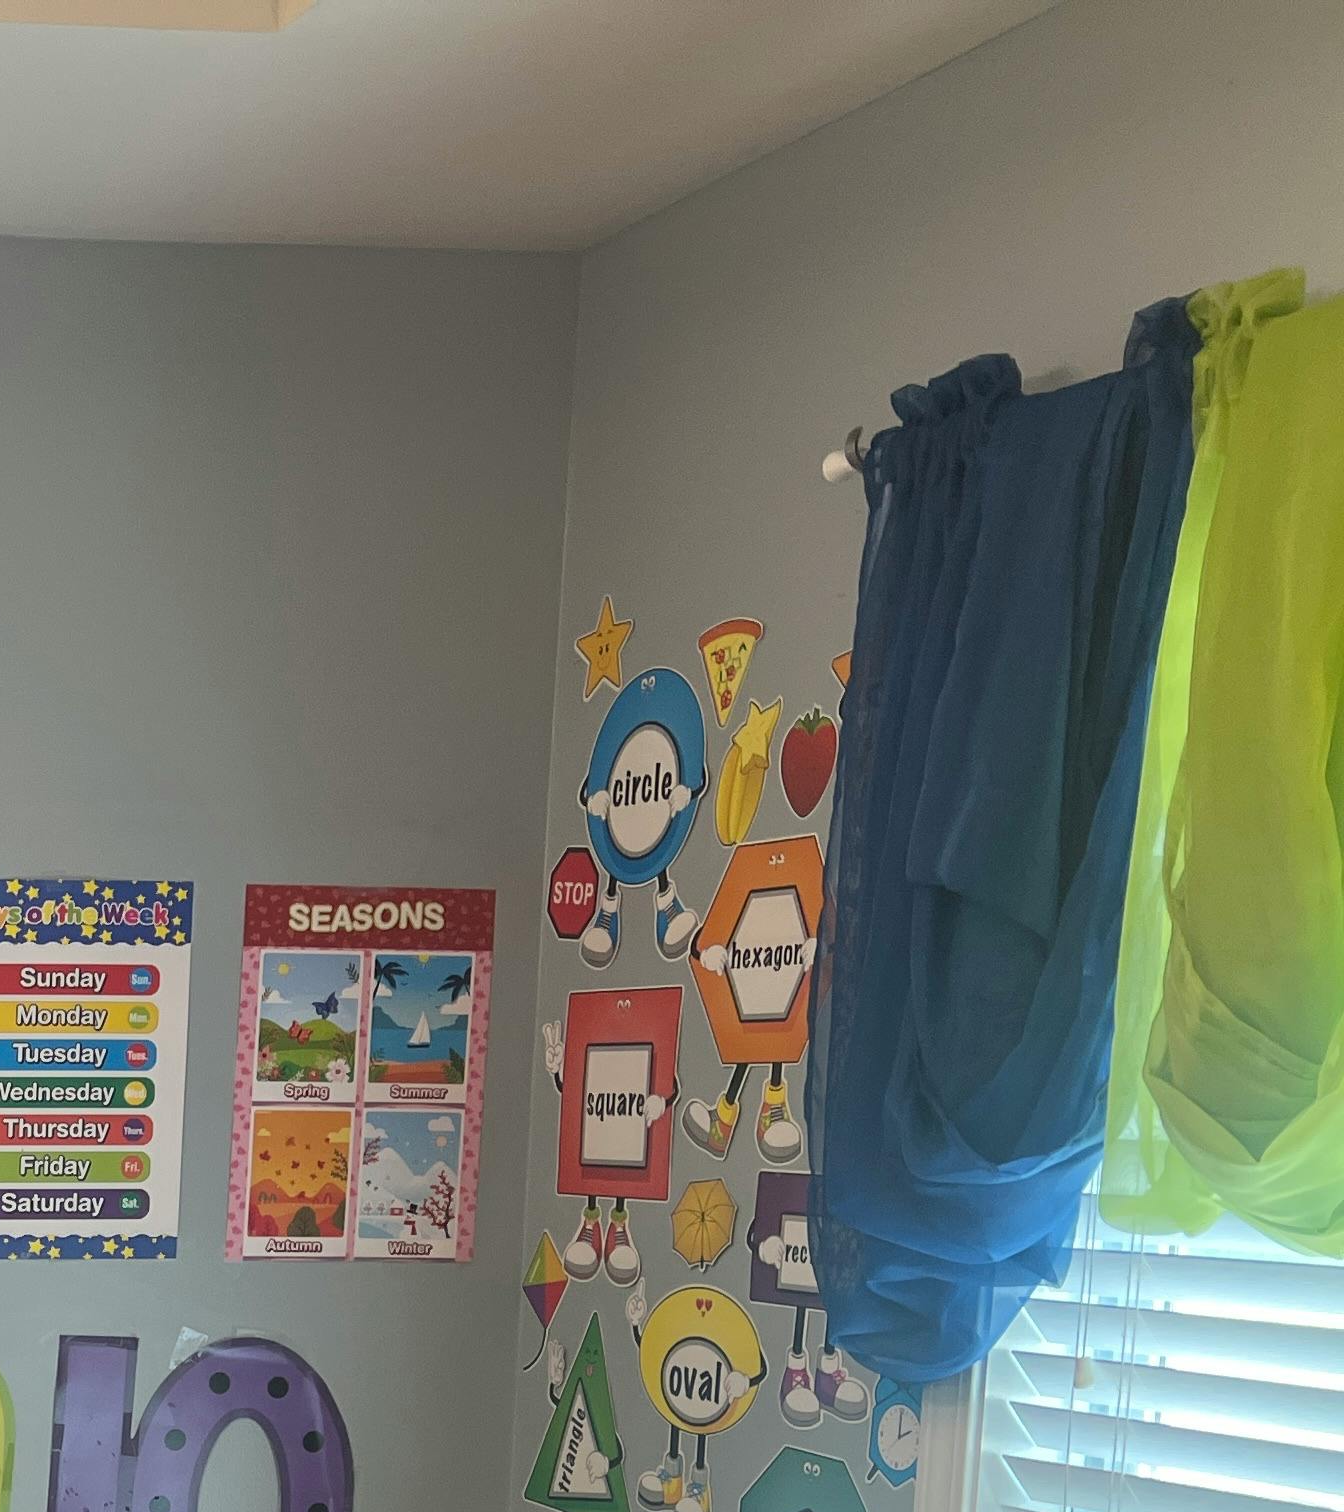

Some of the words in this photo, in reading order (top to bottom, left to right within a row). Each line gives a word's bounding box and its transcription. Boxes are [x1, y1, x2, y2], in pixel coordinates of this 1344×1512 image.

[612, 761, 673, 807] circle
[553, 880, 594, 905] STOP
[26, 900, 55, 925] of
[56, 902, 98, 925] the
[102, 902, 170, 926] Week
[288, 901, 445, 932] SEASONS
[731, 941, 803, 971] hexagon
[20, 967, 106, 992] Sunday
[16, 1004, 108, 1031] Monday
[13, 1043, 107, 1068] Tuesday
[284, 1083, 330, 1099] Spring
[390, 1084, 448, 1099] Summer
[587, 1092, 646, 1122] square
[3, 1118, 110, 1143] Thursday
[19, 1155, 91, 1180] Friday
[124, 1161, 140, 1173] Fri.
[1, 1193, 104, 1217] Saturday
[122, 1197, 139, 1209] Sat.
[265, 1239, 322, 1253] Autumn
[388, 1241, 433, 1256] Winter
[669, 1360, 722, 1405] oval
[558, 1408, 586, 1493] triangle
